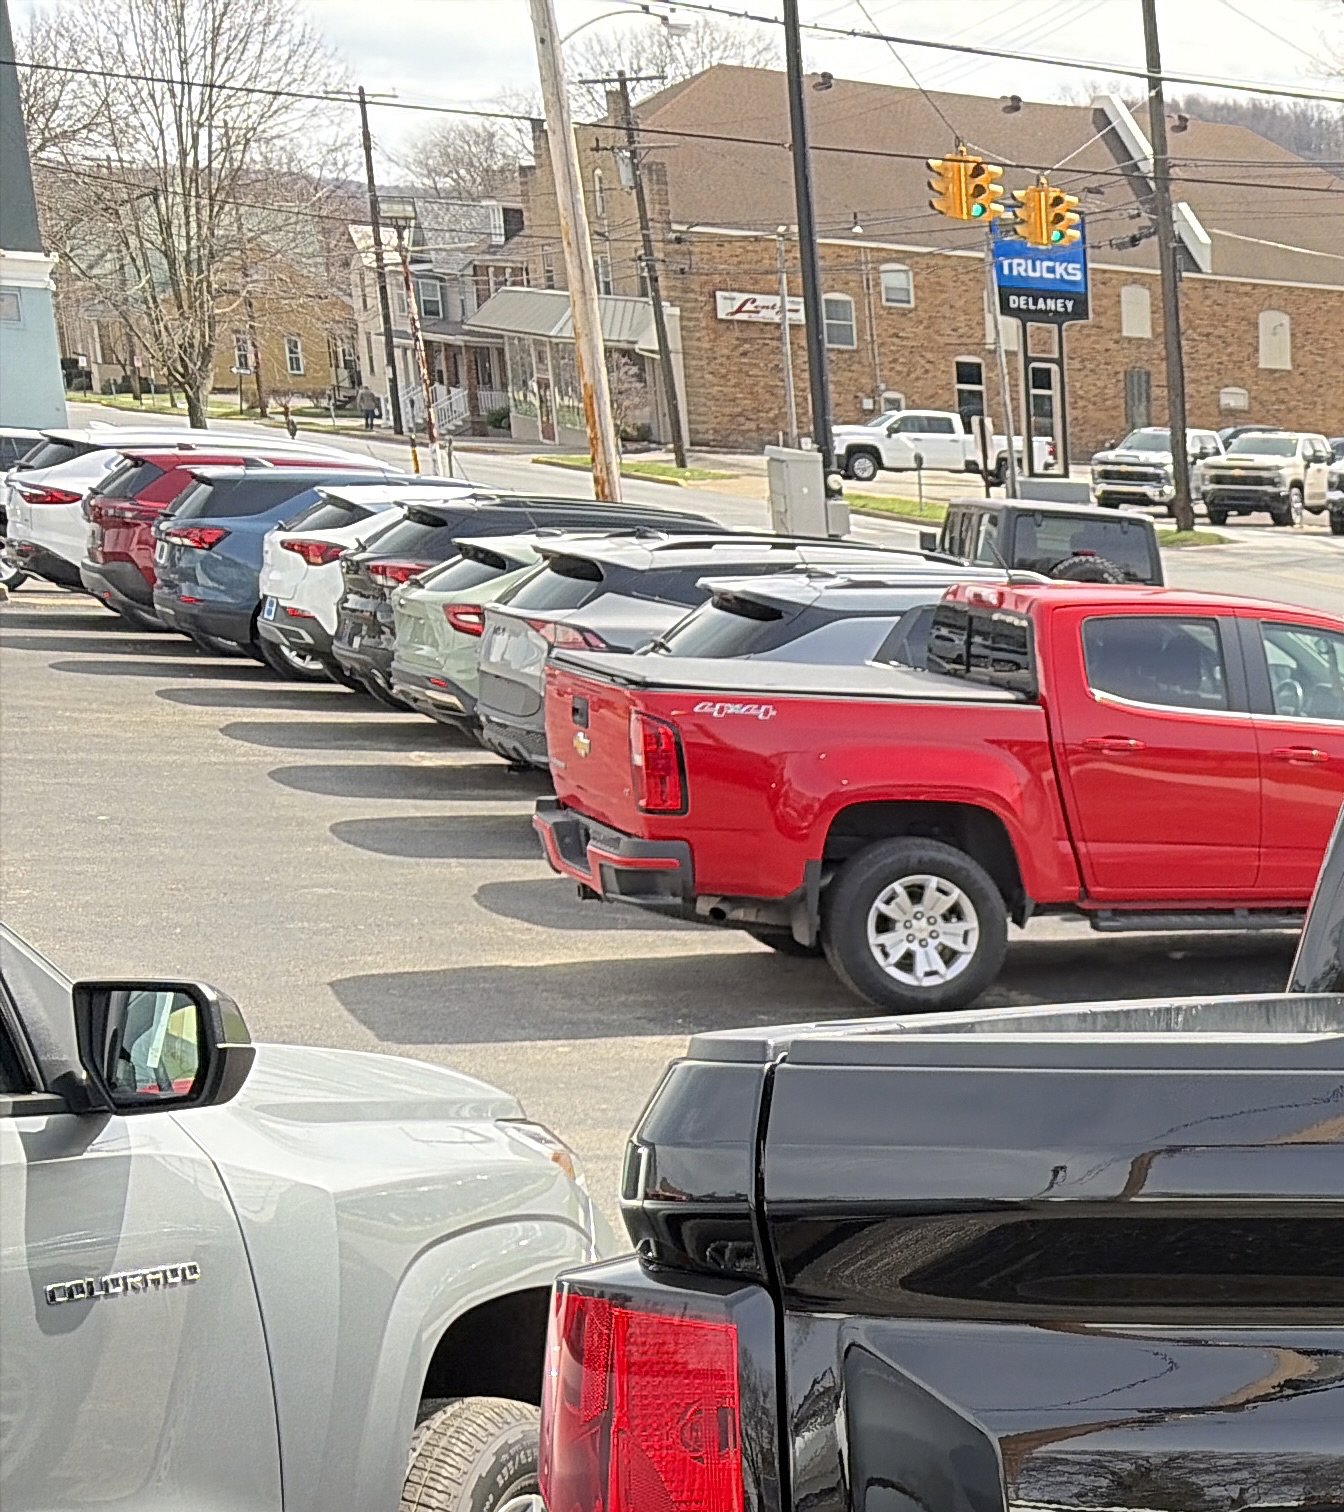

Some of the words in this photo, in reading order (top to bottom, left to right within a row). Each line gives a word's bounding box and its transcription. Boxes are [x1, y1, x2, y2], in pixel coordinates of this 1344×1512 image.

[1000, 256, 1082, 281] TRUCKS
[1009, 295, 1074, 313] DELANEY
[44, 1261, 201, 1305] COLORADO
